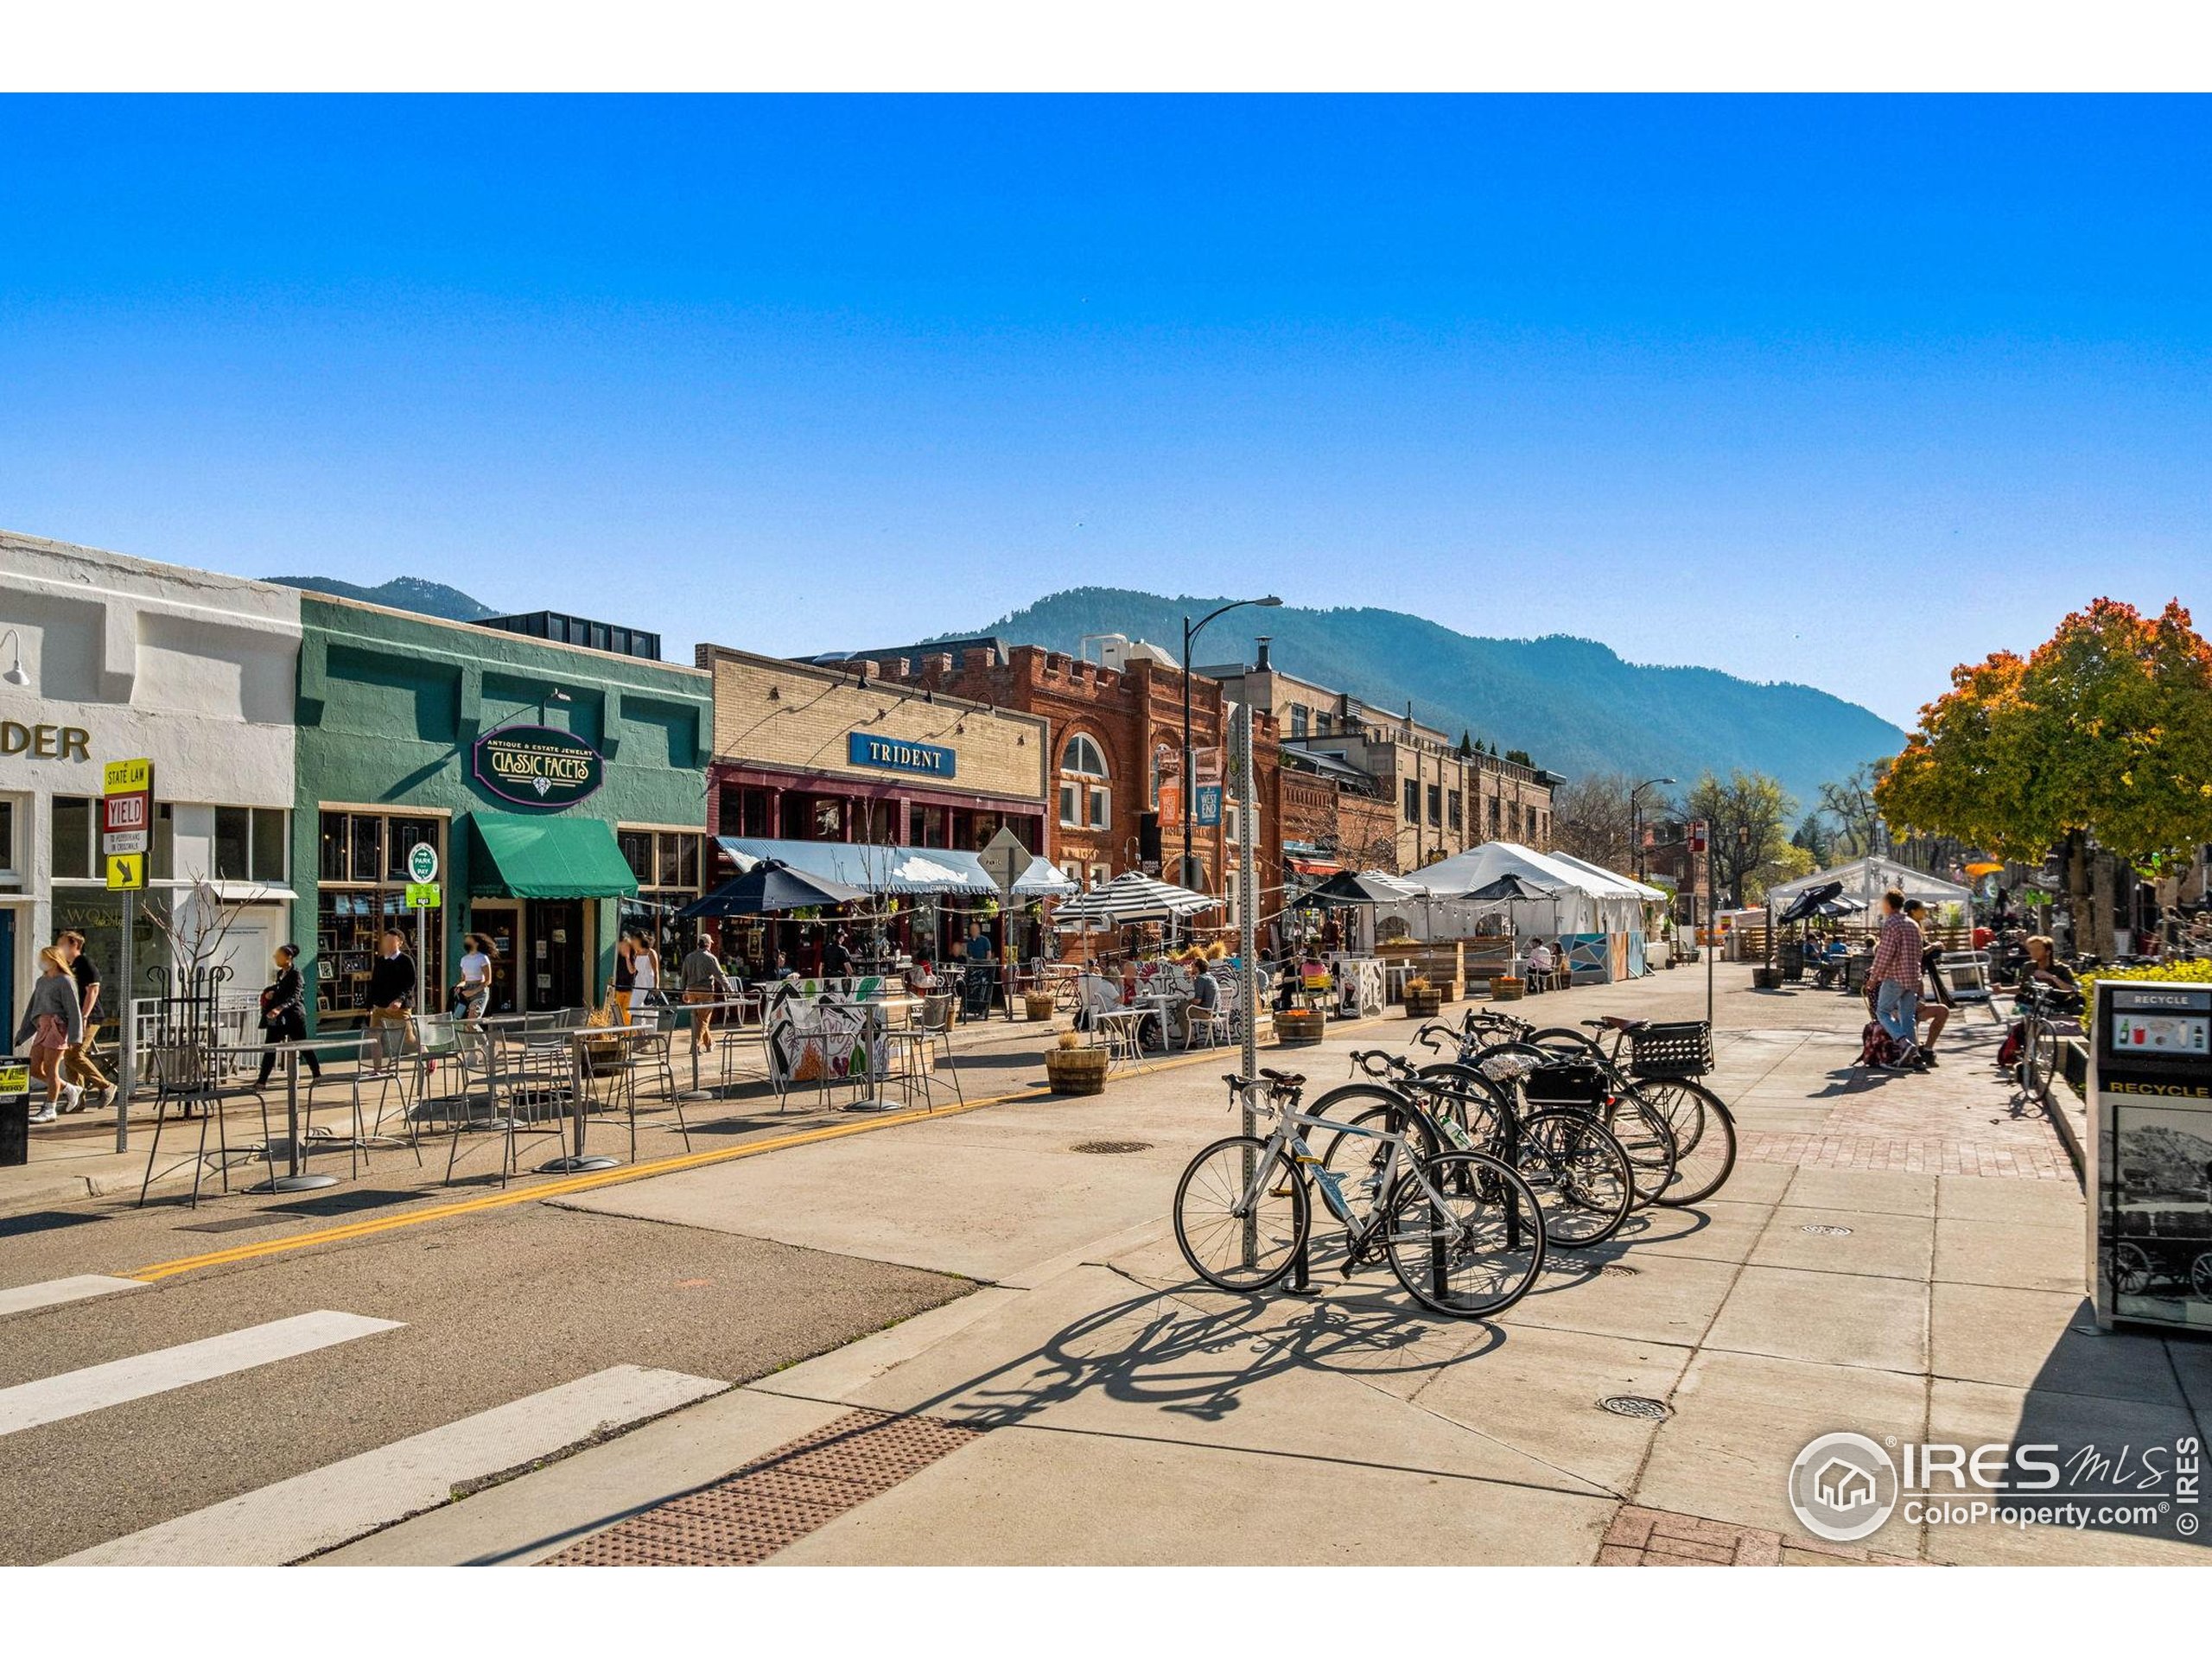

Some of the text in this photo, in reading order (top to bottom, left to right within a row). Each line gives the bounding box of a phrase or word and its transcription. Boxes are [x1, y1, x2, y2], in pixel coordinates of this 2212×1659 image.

[2, 721, 91, 760] DER
[487, 740, 521, 749] ANTIQUE
[532, 744, 559, 753] ESTATE
[561, 747, 593, 756] JEWELRY
[870, 742, 942, 768] TRIDENT
[492, 752, 588, 779] CLASSIC FACETS
[108, 767, 144, 785] STATE LAW
[1201, 793, 1217, 804] WEST
[110, 799, 142, 824] YIELD
[1202, 804, 1217, 815] END
[2134, 995, 2190, 1005] RECYCLE
[2110, 1082, 2210, 1098] RECYCLE
